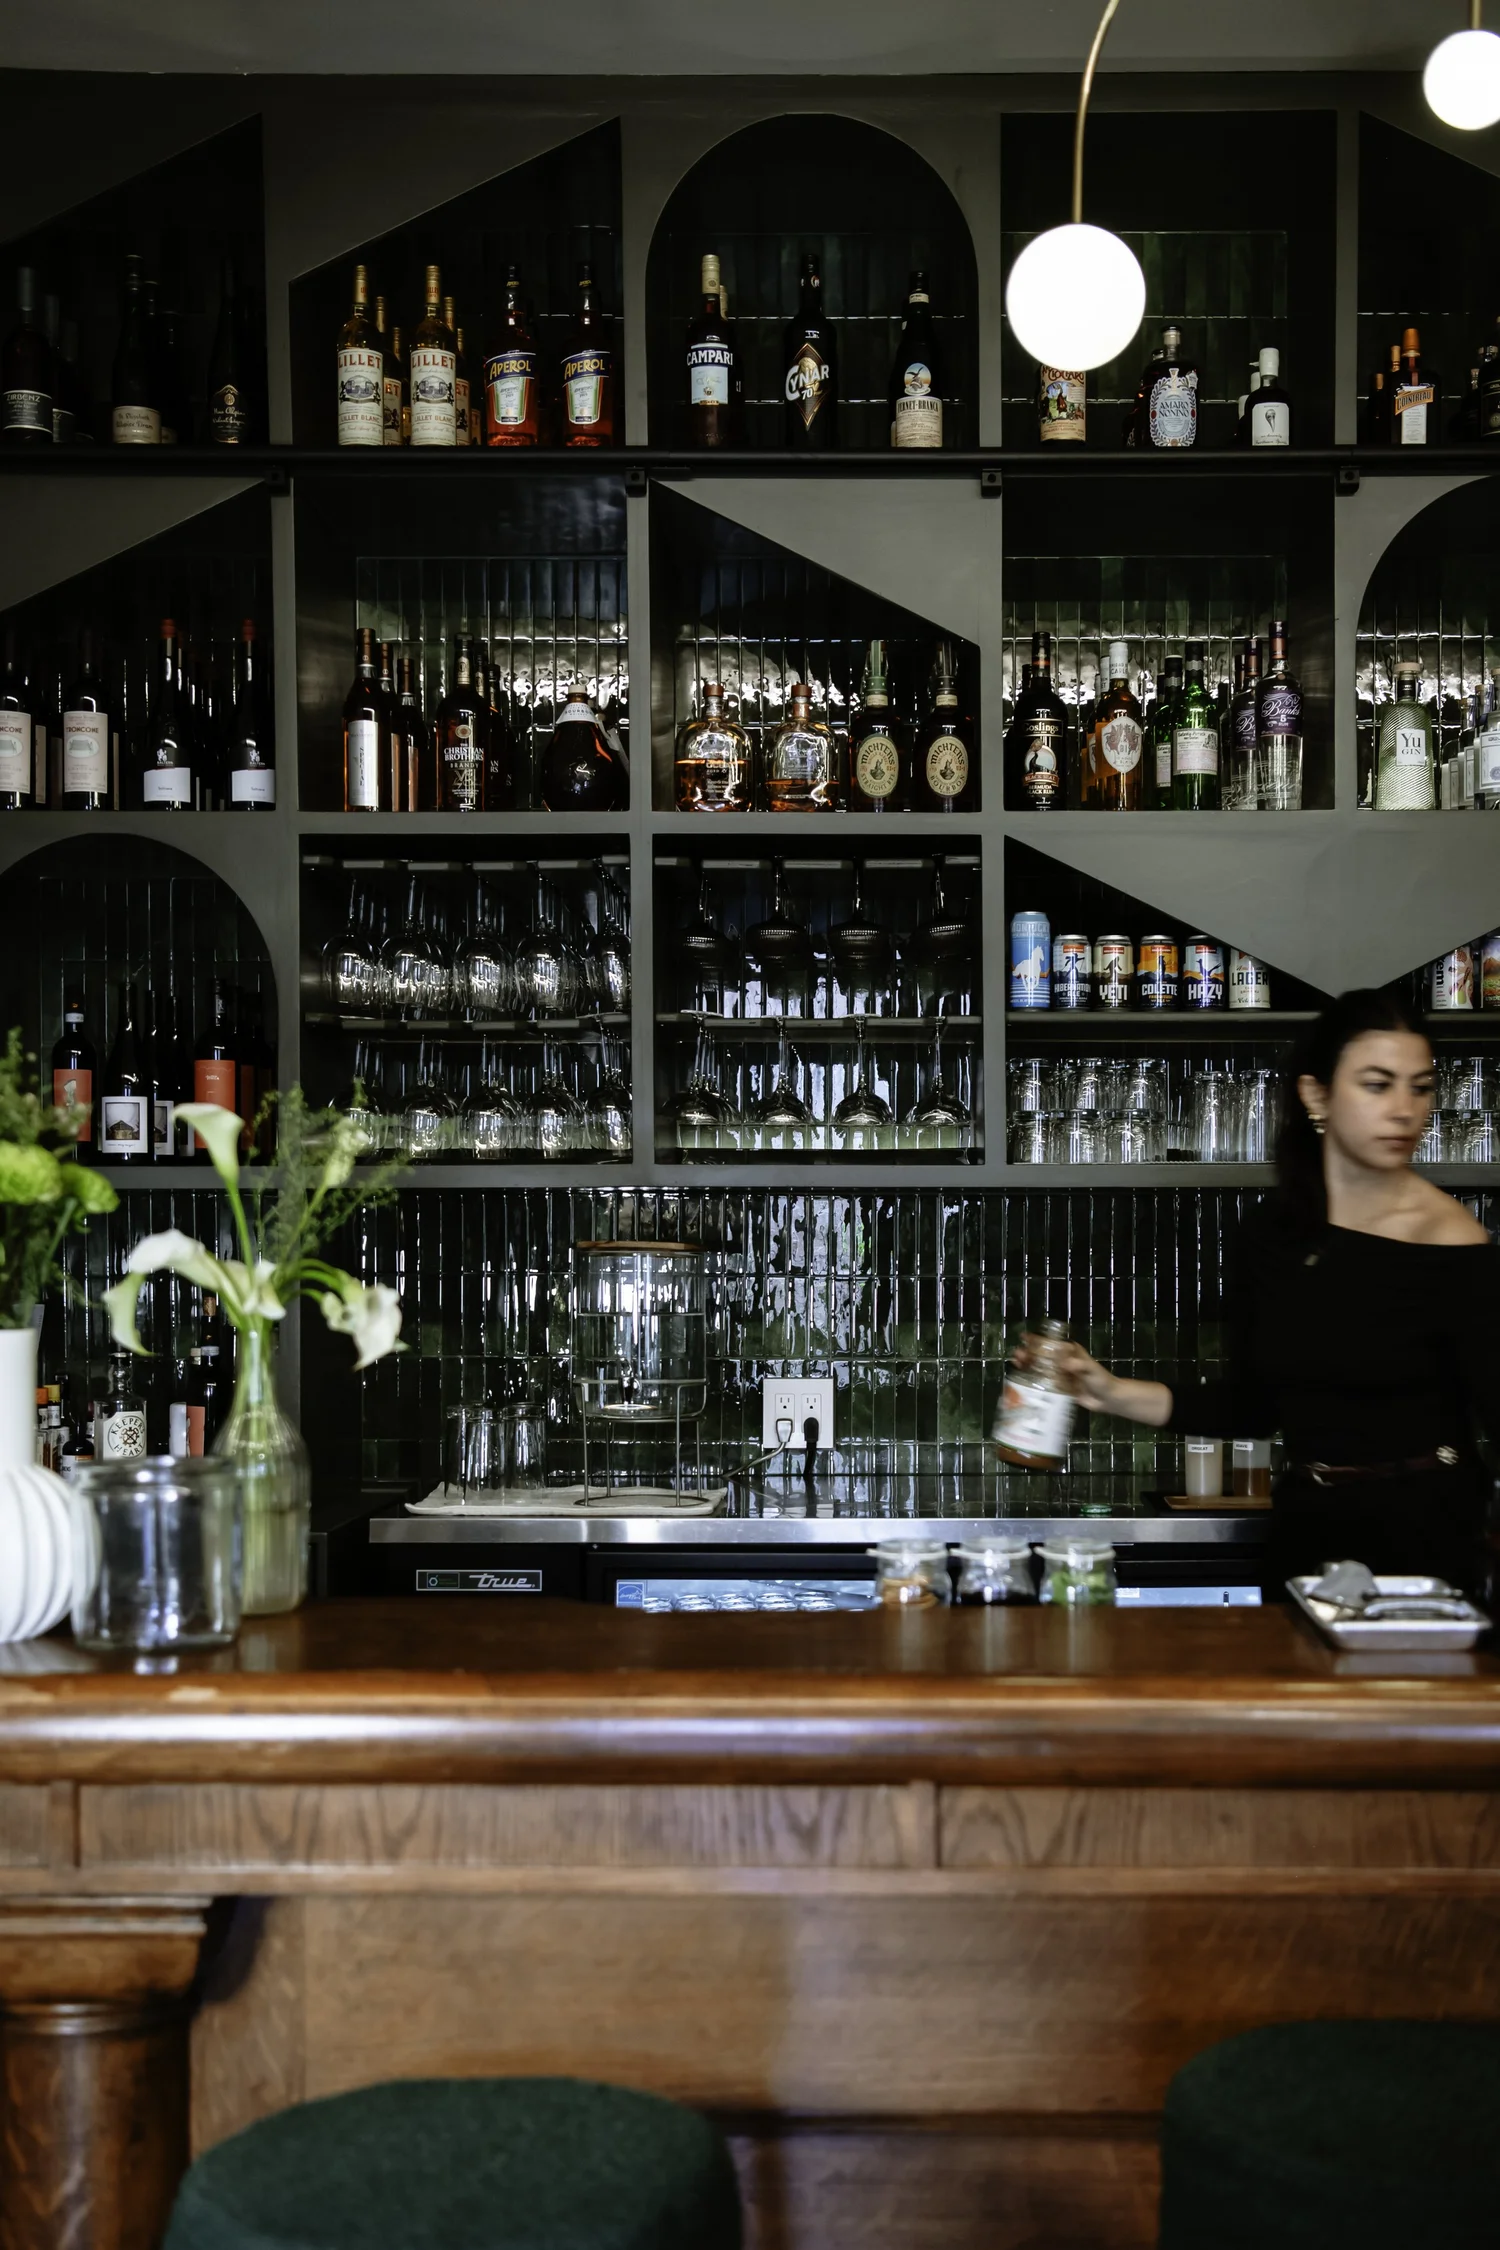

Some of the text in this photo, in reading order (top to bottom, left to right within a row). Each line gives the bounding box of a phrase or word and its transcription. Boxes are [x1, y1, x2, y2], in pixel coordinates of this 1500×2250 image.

[338, 354, 381, 369] LILLET
[412, 355, 454, 369] LILLET
[686, 350, 734, 366] CAMPARI
[490, 360, 531, 380] APEROL
[564, 358, 605, 380] APEROL
[785, 364, 830, 401] CYNAR
[801, 388, 814, 400] 70
[1397, 390, 1432, 410] COINTREAU
[1160, 401, 1189, 409] AMARO
[1159, 409, 1189, 418] NONINO
[1262, 699, 1300, 718] Banks
[1401, 733, 1421, 748] Yu
[1232, 971, 1268, 986] LAGER
[1100, 985, 1128, 1000] YETI
[1142, 984, 1177, 996] COLETTE
[1188, 984, 1223, 1000] HAZY
[113, 1443, 143, 1457] HEART
[469, 1573, 532, 1588] true
